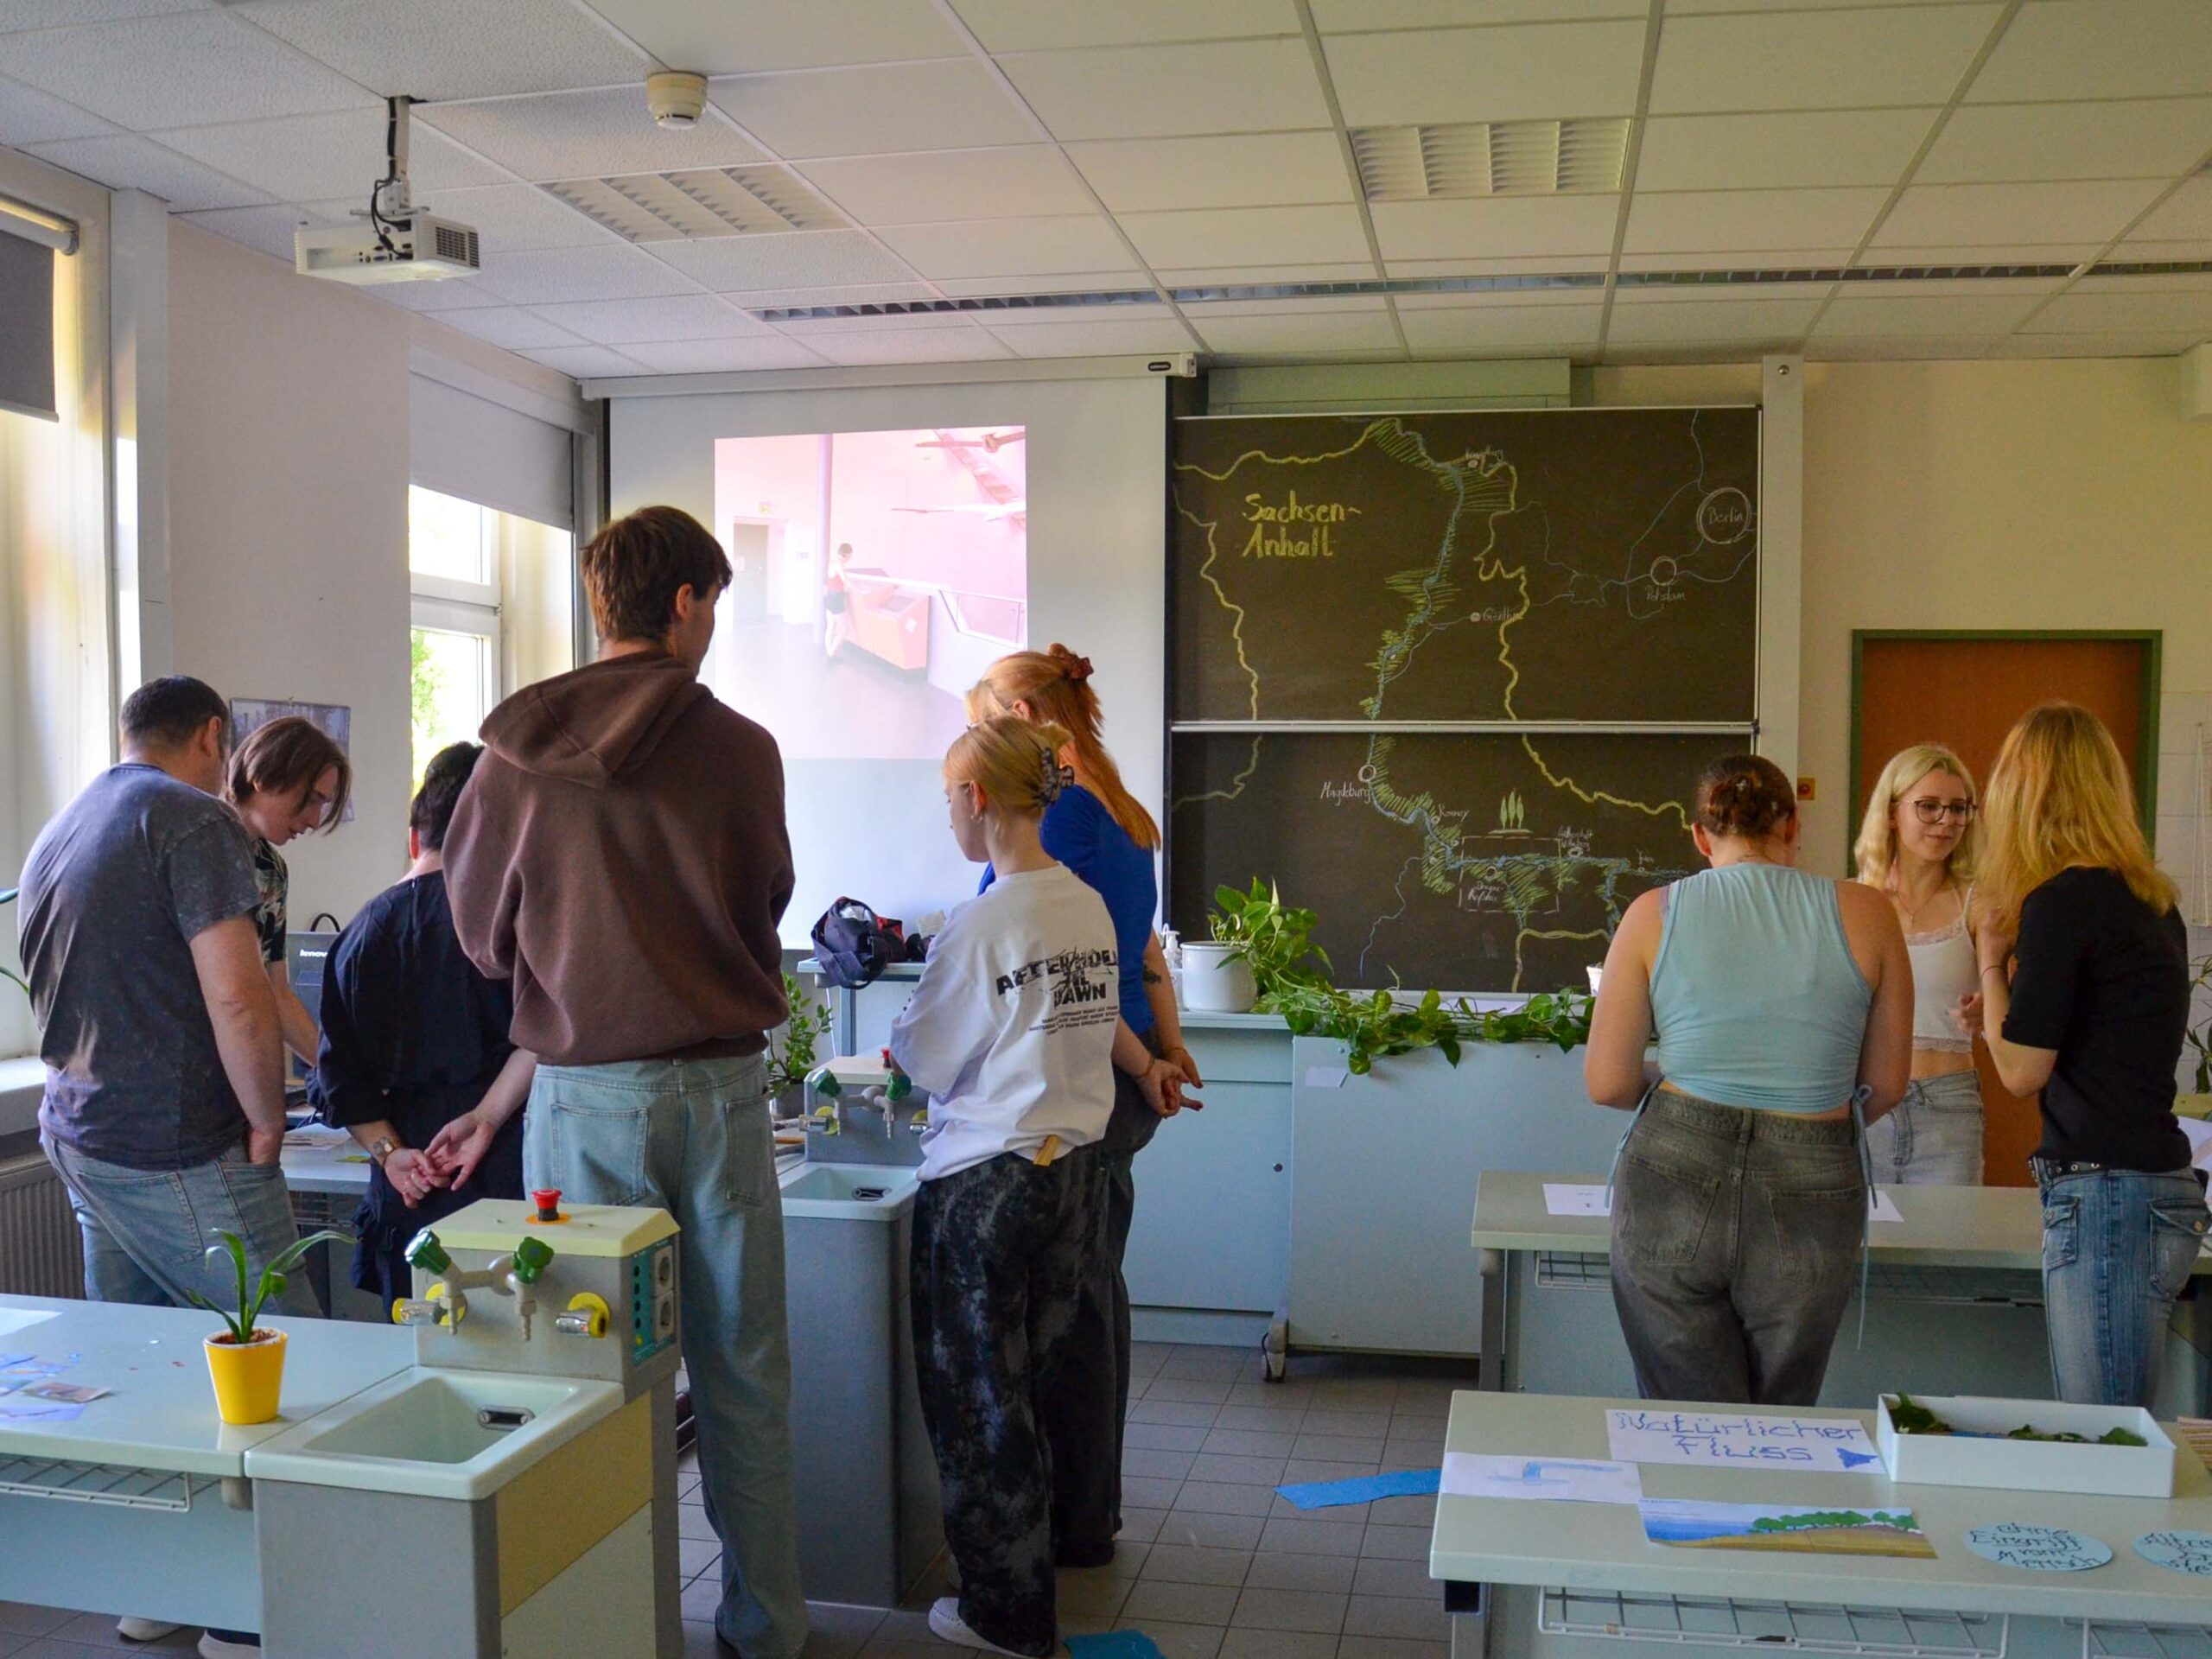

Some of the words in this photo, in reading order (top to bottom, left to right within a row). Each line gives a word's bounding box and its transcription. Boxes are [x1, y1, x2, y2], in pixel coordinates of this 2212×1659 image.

[1242, 489, 1362, 523] Sachsen-
[1707, 505, 1745, 524] Berlin
[1242, 523, 1336, 558] Anhalt
[1320, 781, 1371, 806] Magdeburg
[1053, 982, 1106, 1010] DAWN
[1616, 1412, 1862, 1440] Natürlicher
